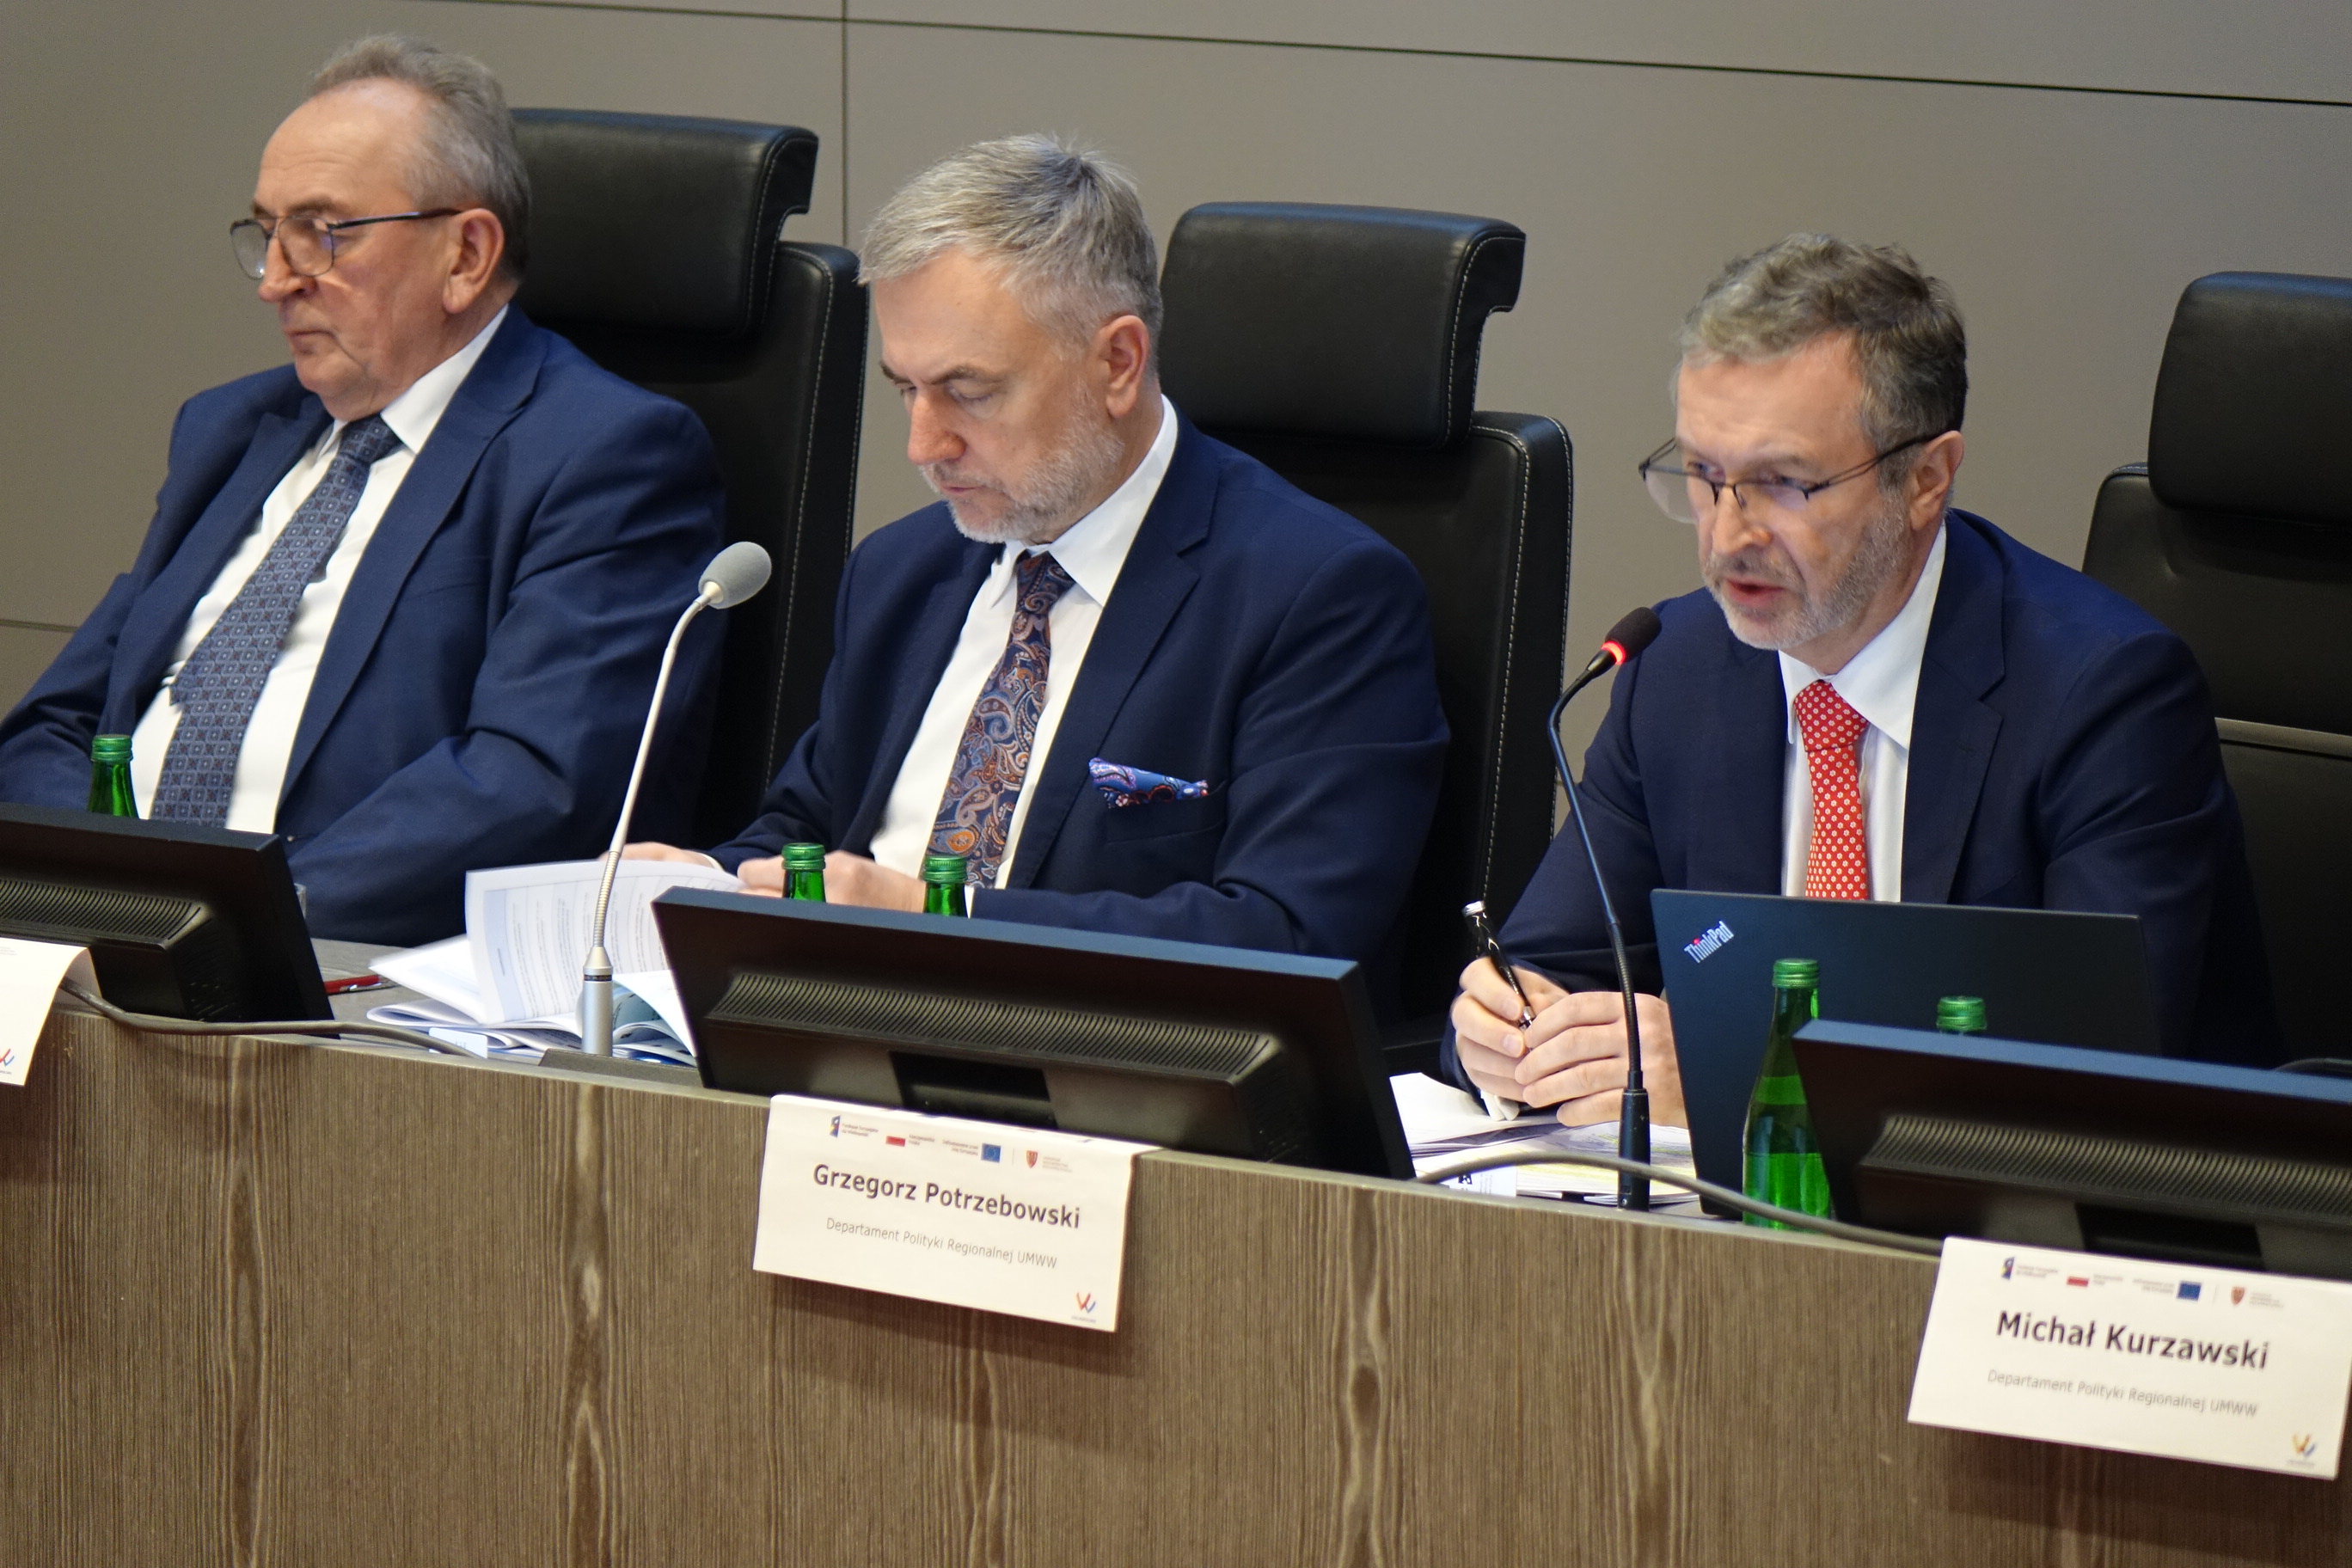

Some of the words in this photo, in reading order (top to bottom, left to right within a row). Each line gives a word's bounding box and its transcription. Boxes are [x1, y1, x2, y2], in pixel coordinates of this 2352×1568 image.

[1683, 921, 1734, 963] ThinkPad
[813, 1163, 917, 1200] Grzegorz
[925, 1182, 1080, 1228] Potrzebowski
[826, 1217, 899, 1242] Departament
[903, 1230, 943, 1250] Polityki
[947, 1238, 1014, 1264] Regionalnej
[1017, 1251, 1057, 1269] UMWW
[1996, 1310, 2096, 1348] Michał
[2105, 1324, 2269, 1369] Kurzawski
[1988, 1369, 2073, 1393] Departament
[2077, 1381, 2125, 1400] Polityki
[2128, 1387, 2206, 1412] Regionalnej
[2210, 1399, 2258, 1418] UMWW
